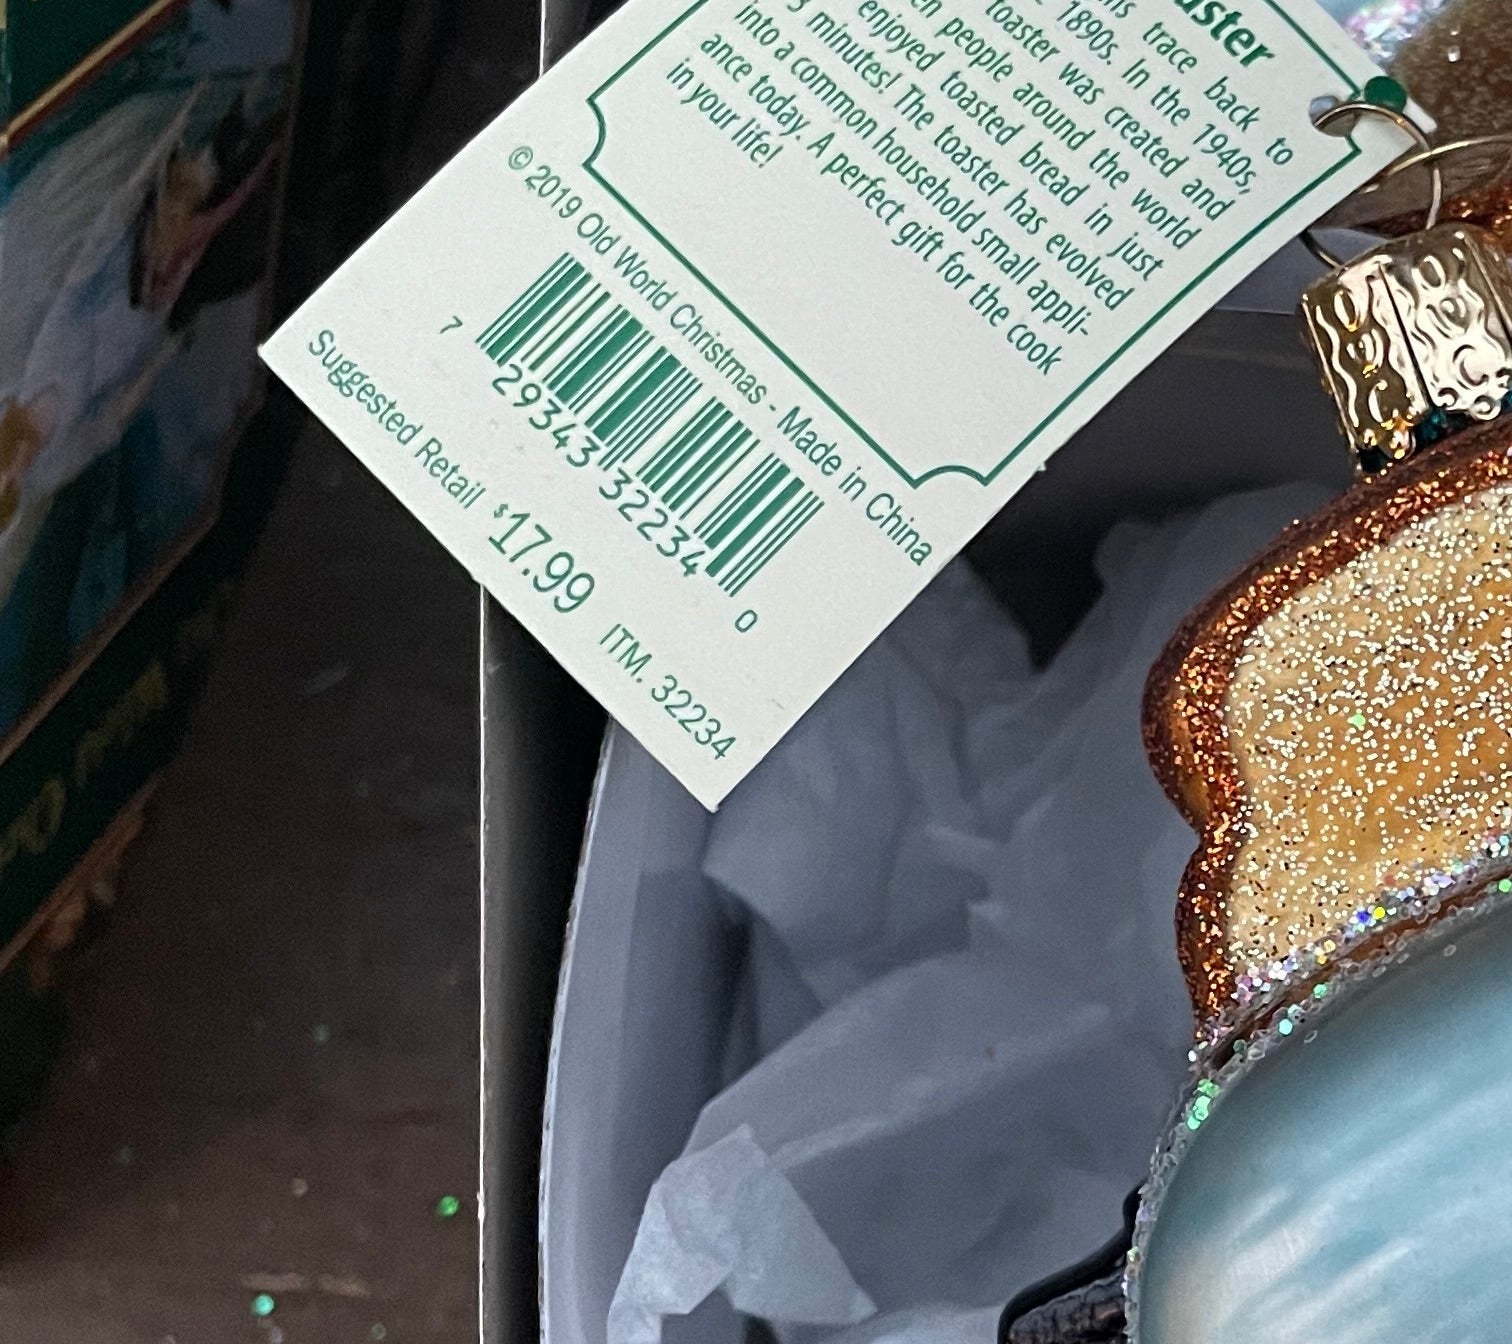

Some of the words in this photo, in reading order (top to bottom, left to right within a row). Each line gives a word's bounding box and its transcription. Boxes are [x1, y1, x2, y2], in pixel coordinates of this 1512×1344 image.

[666, 57, 695, 90] in
[700, 33, 753, 83] ance
[1142, 21, 1198, 75] trace
[1203, 75, 1261, 133] back
[1264, 137, 1294, 166] to
[679, 81, 741, 131] your
[747, 74, 811, 141] today.
[933, 17, 1014, 83] people
[1012, 82, 1097, 152] around
[1088, 147, 1130, 191] the
[1130, 187, 1203, 251] world
[1056, 0, 1119, 66] 1890s.
[1120, 57, 1151, 90] In
[1150, 84, 1191, 127] the
[1192, 123, 1257, 195] 1940s,
[730, 117, 784, 169] life!
[733, 0, 781, 47] into
[773, 41, 796, 62] a
[790, 56, 878, 141] common
[871, 126, 987, 234] household
[970, 227, 1042, 286] small
[1026, 279, 1092, 336] appli-
[805, 11, 904, 95] minutes!
[893, 82, 935, 131] The
[933, 124, 1011, 197] toaster
[1003, 188, 1049, 236] has
[1045, 233, 1135, 312] evolved
[806, 131, 836, 159] A
[857, 0, 946, 73] enjoyed
[939, 70, 1026, 147] toasted
[1017, 140, 1091, 207] bread
[1083, 202, 1114, 236] in
[1105, 231, 1165, 282] just
[1058, 61, 1105, 106] was
[1104, 106, 1190, 179] created
[1180, 177, 1236, 222] and
[819, 152, 906, 226] perfect
[890, 220, 945, 263] gift
[935, 250, 976, 291] for
[968, 282, 1010, 328] the
[524, 164, 583, 219] 2019
[576, 212, 622, 256] Old
[613, 245, 679, 312] World
[669, 303, 768, 405] Christmas
[776, 405, 842, 477] Made
[838, 466, 867, 502] in
[865, 492, 933, 567] China
[1006, 323, 1063, 377] cook
[439, 315, 463, 335] 7
[492, 363, 601, 468] 29343
[598, 467, 706, 578] 32234
[734, 609, 758, 634] 0
[308, 329, 424, 446] Suggested
[414, 437, 487, 510] Retail
[487, 503, 596, 614] $17.99
[599, 623, 653, 684] ITM.
[650, 674, 737, 760] 32234
